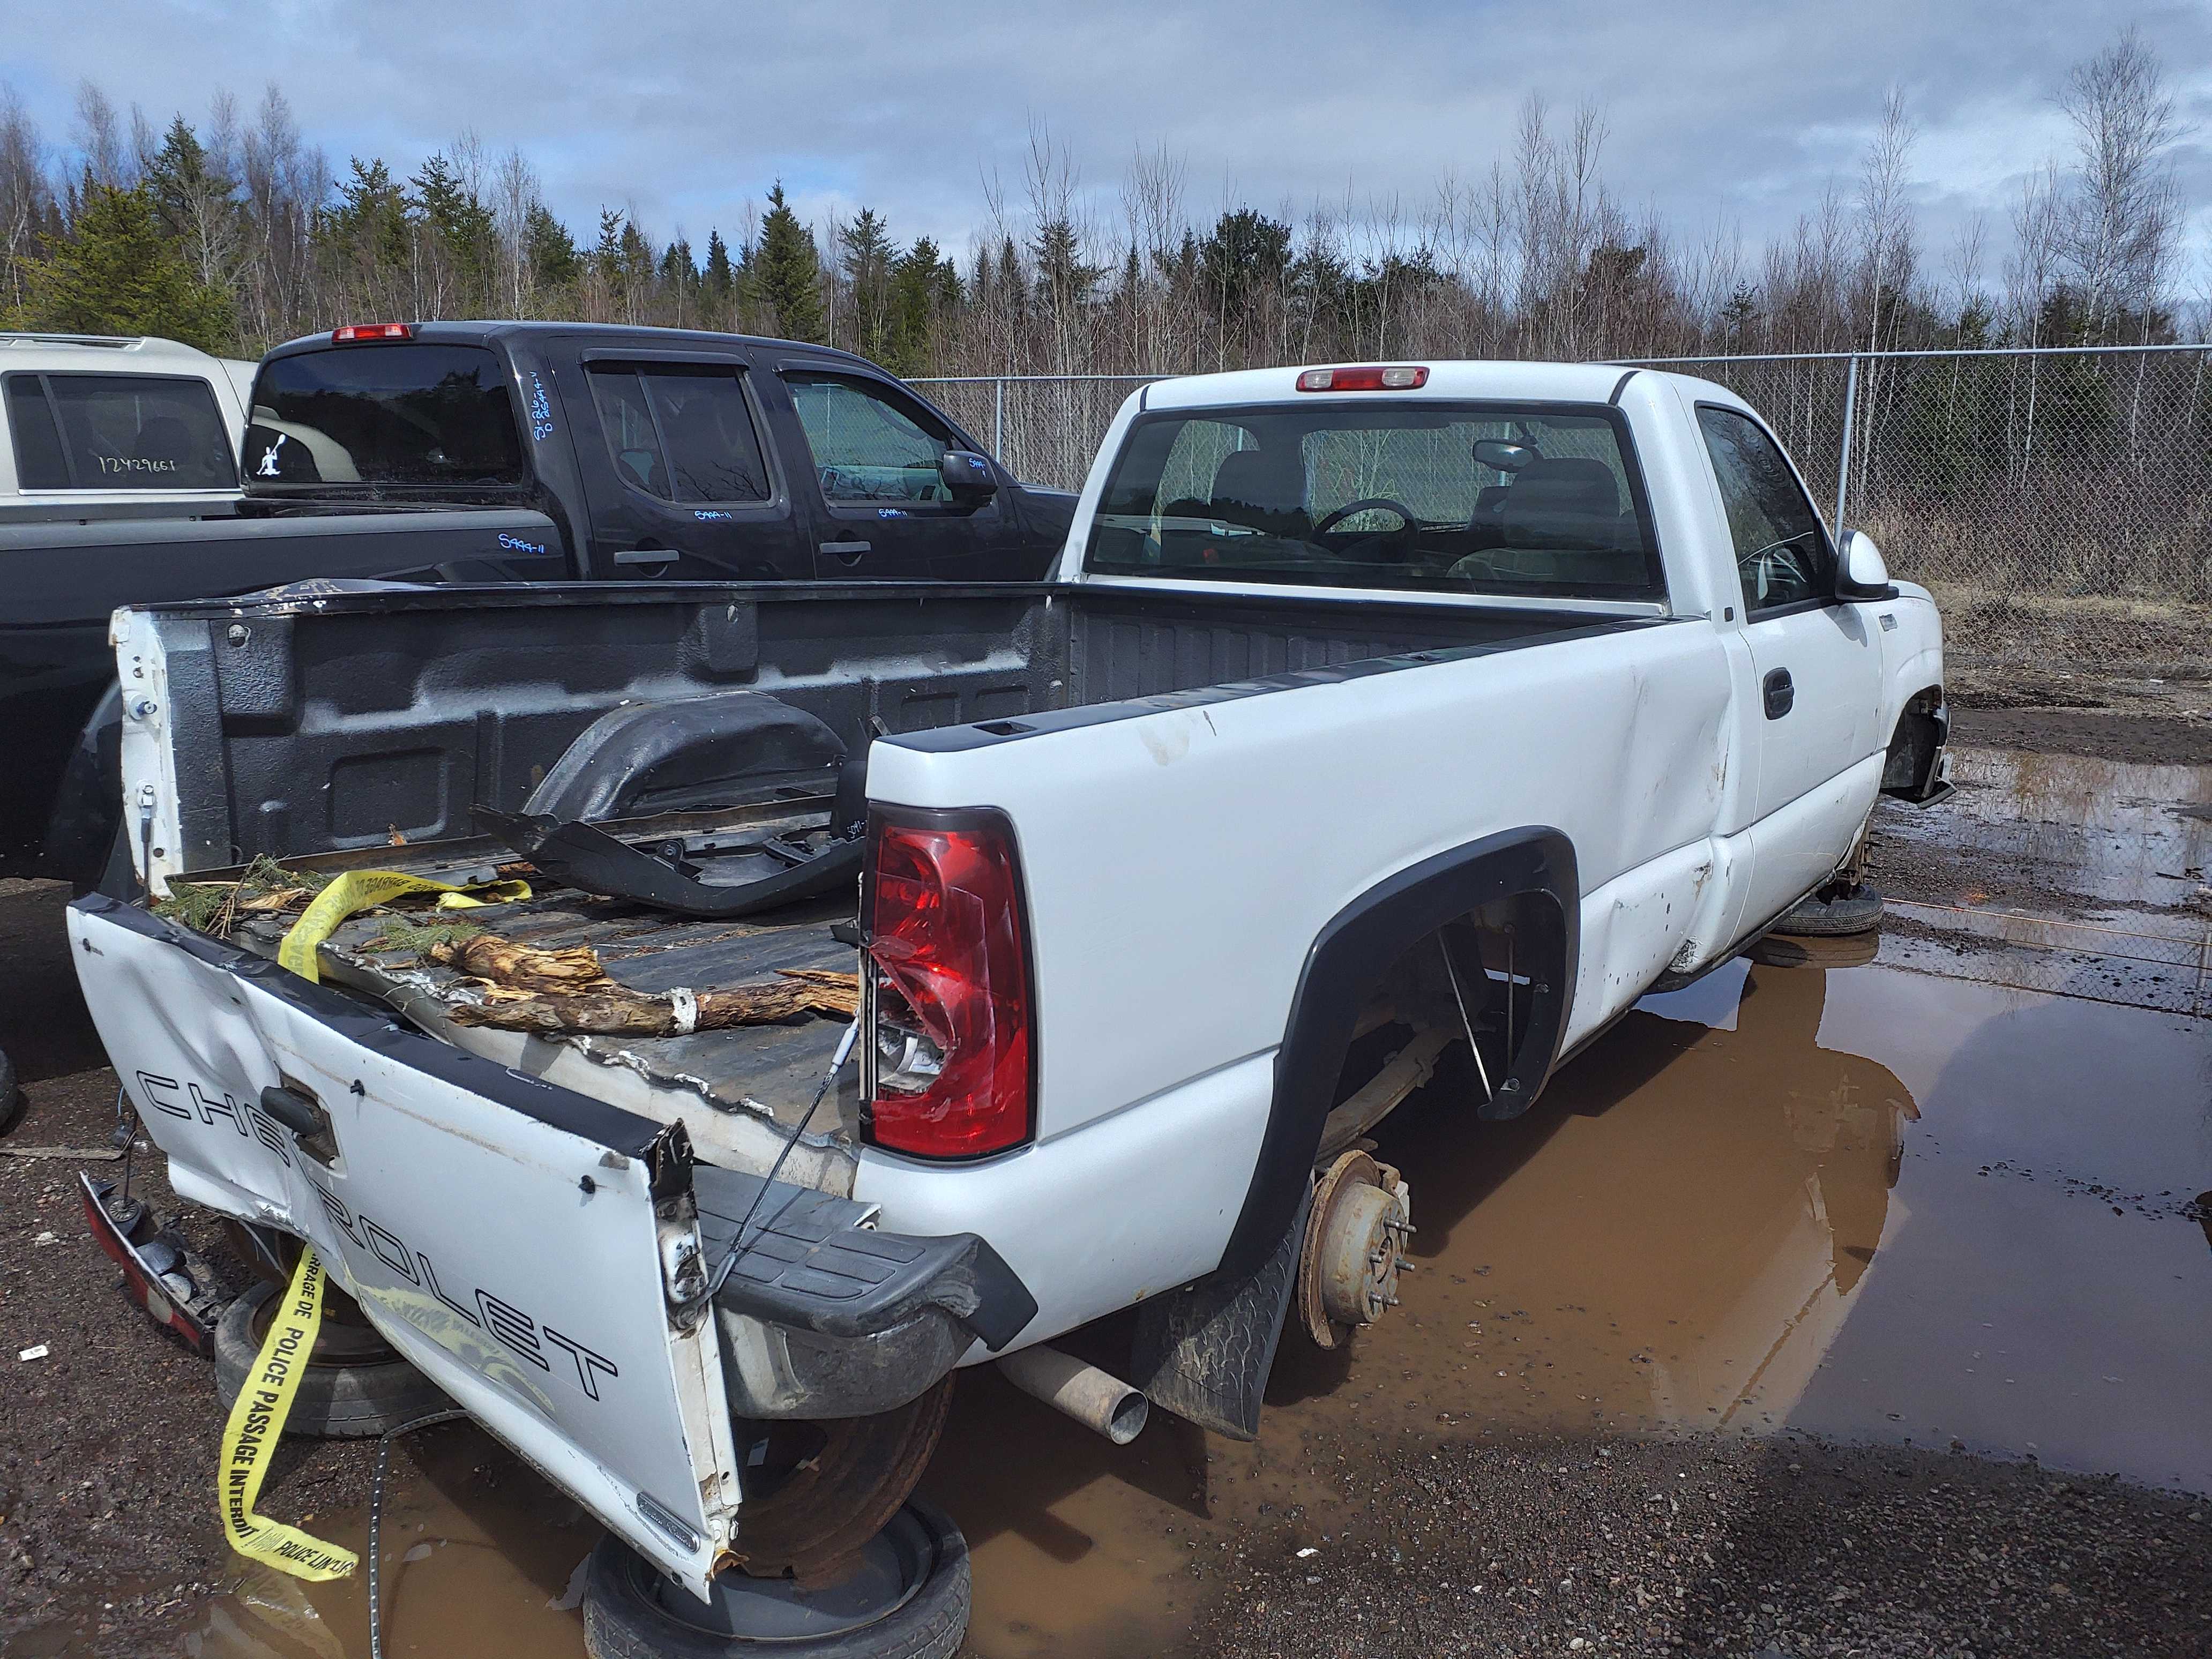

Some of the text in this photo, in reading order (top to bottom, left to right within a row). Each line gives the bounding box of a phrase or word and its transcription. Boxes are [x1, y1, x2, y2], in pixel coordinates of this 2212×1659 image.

[136, 1070, 619, 1402] CHEROLET
[293, 1300, 313, 1319] DE
[261, 1327, 305, 1387] POLICE
[232, 1390, 280, 1466] PASSAGE
[229, 1469, 260, 1538] INTERDIT
[273, 1540, 316, 1563] POLICE
